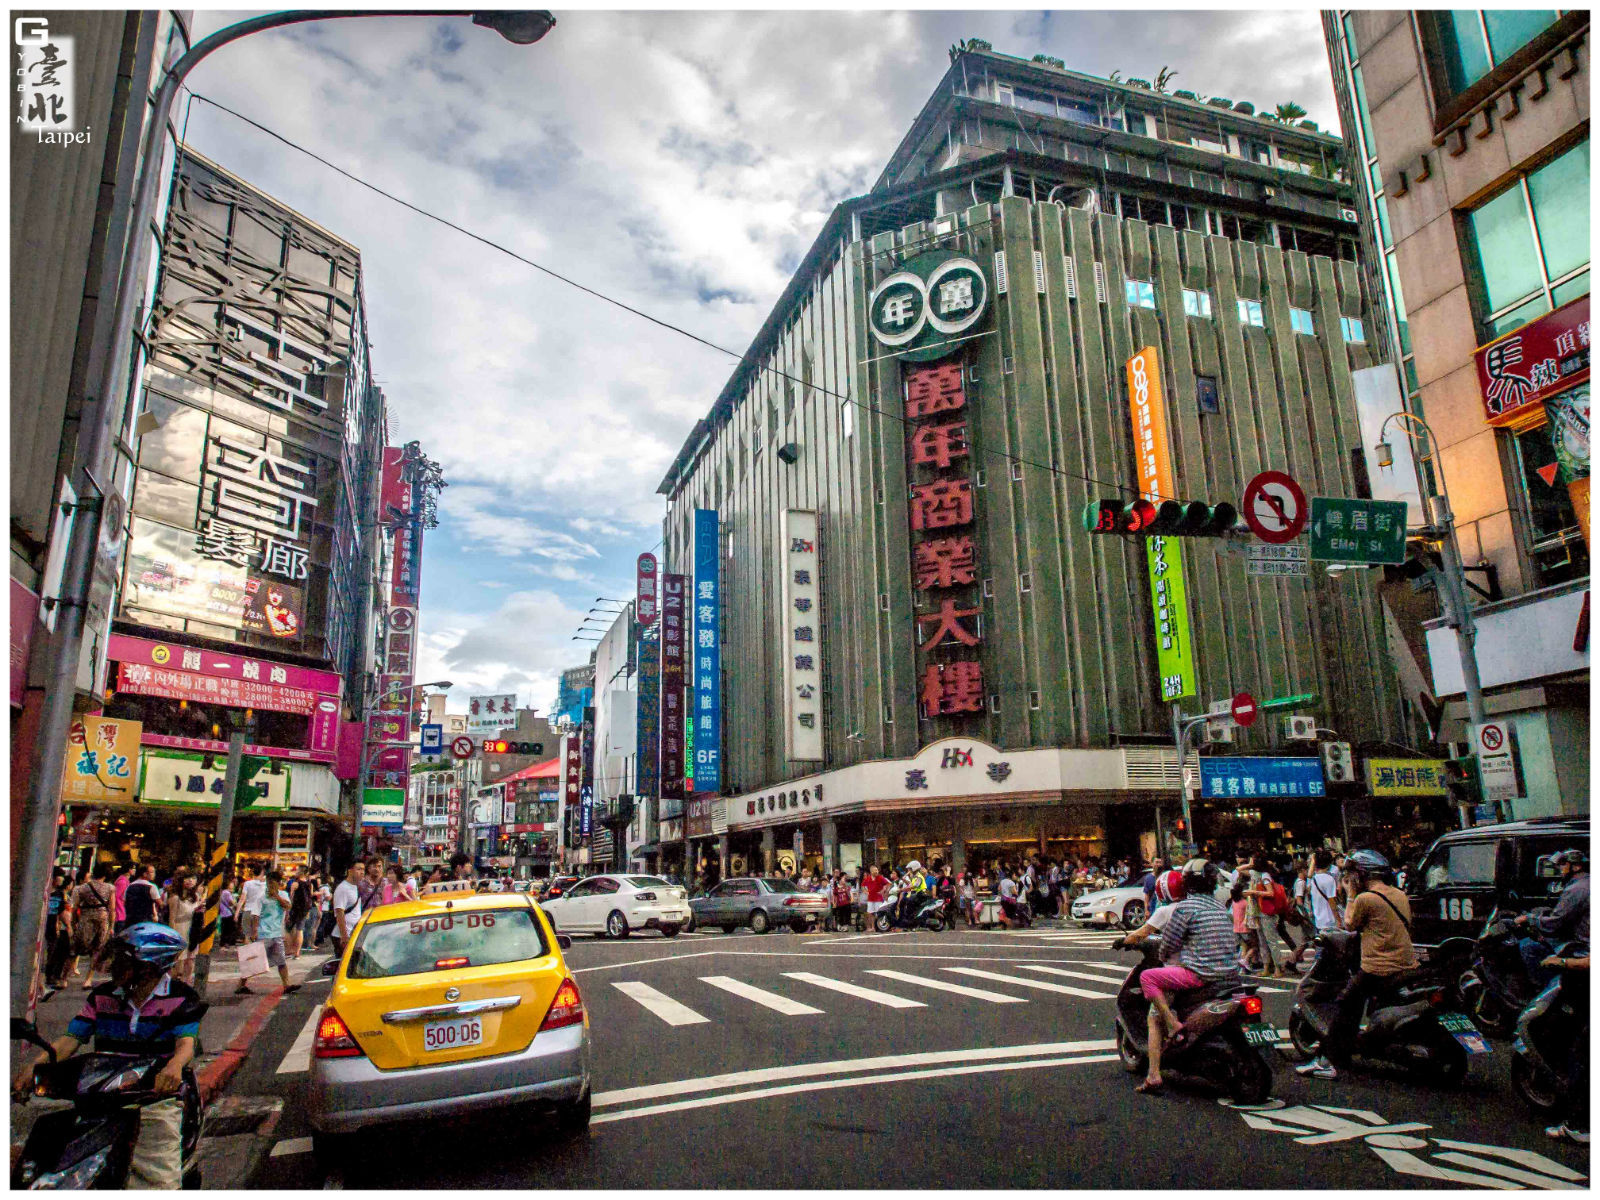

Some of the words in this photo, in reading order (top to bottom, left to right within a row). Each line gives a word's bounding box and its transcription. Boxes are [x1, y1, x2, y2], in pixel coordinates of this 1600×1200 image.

[200, 518, 311, 581] 髮廊
[905, 363, 983, 717] 萬年商業大樓
[793, 569, 816, 729] 豪華鐘錶公司
[1163, 674, 1181, 687] 24H
[76, 751, 131, 777] 福記
[697, 749, 718, 764] 6F
[362, 808, 402, 818] FamilyMart
[431, 882, 467, 894] TAXI
[1439, 898, 1474, 921] 166
[409, 913, 496, 935] 500-D6
